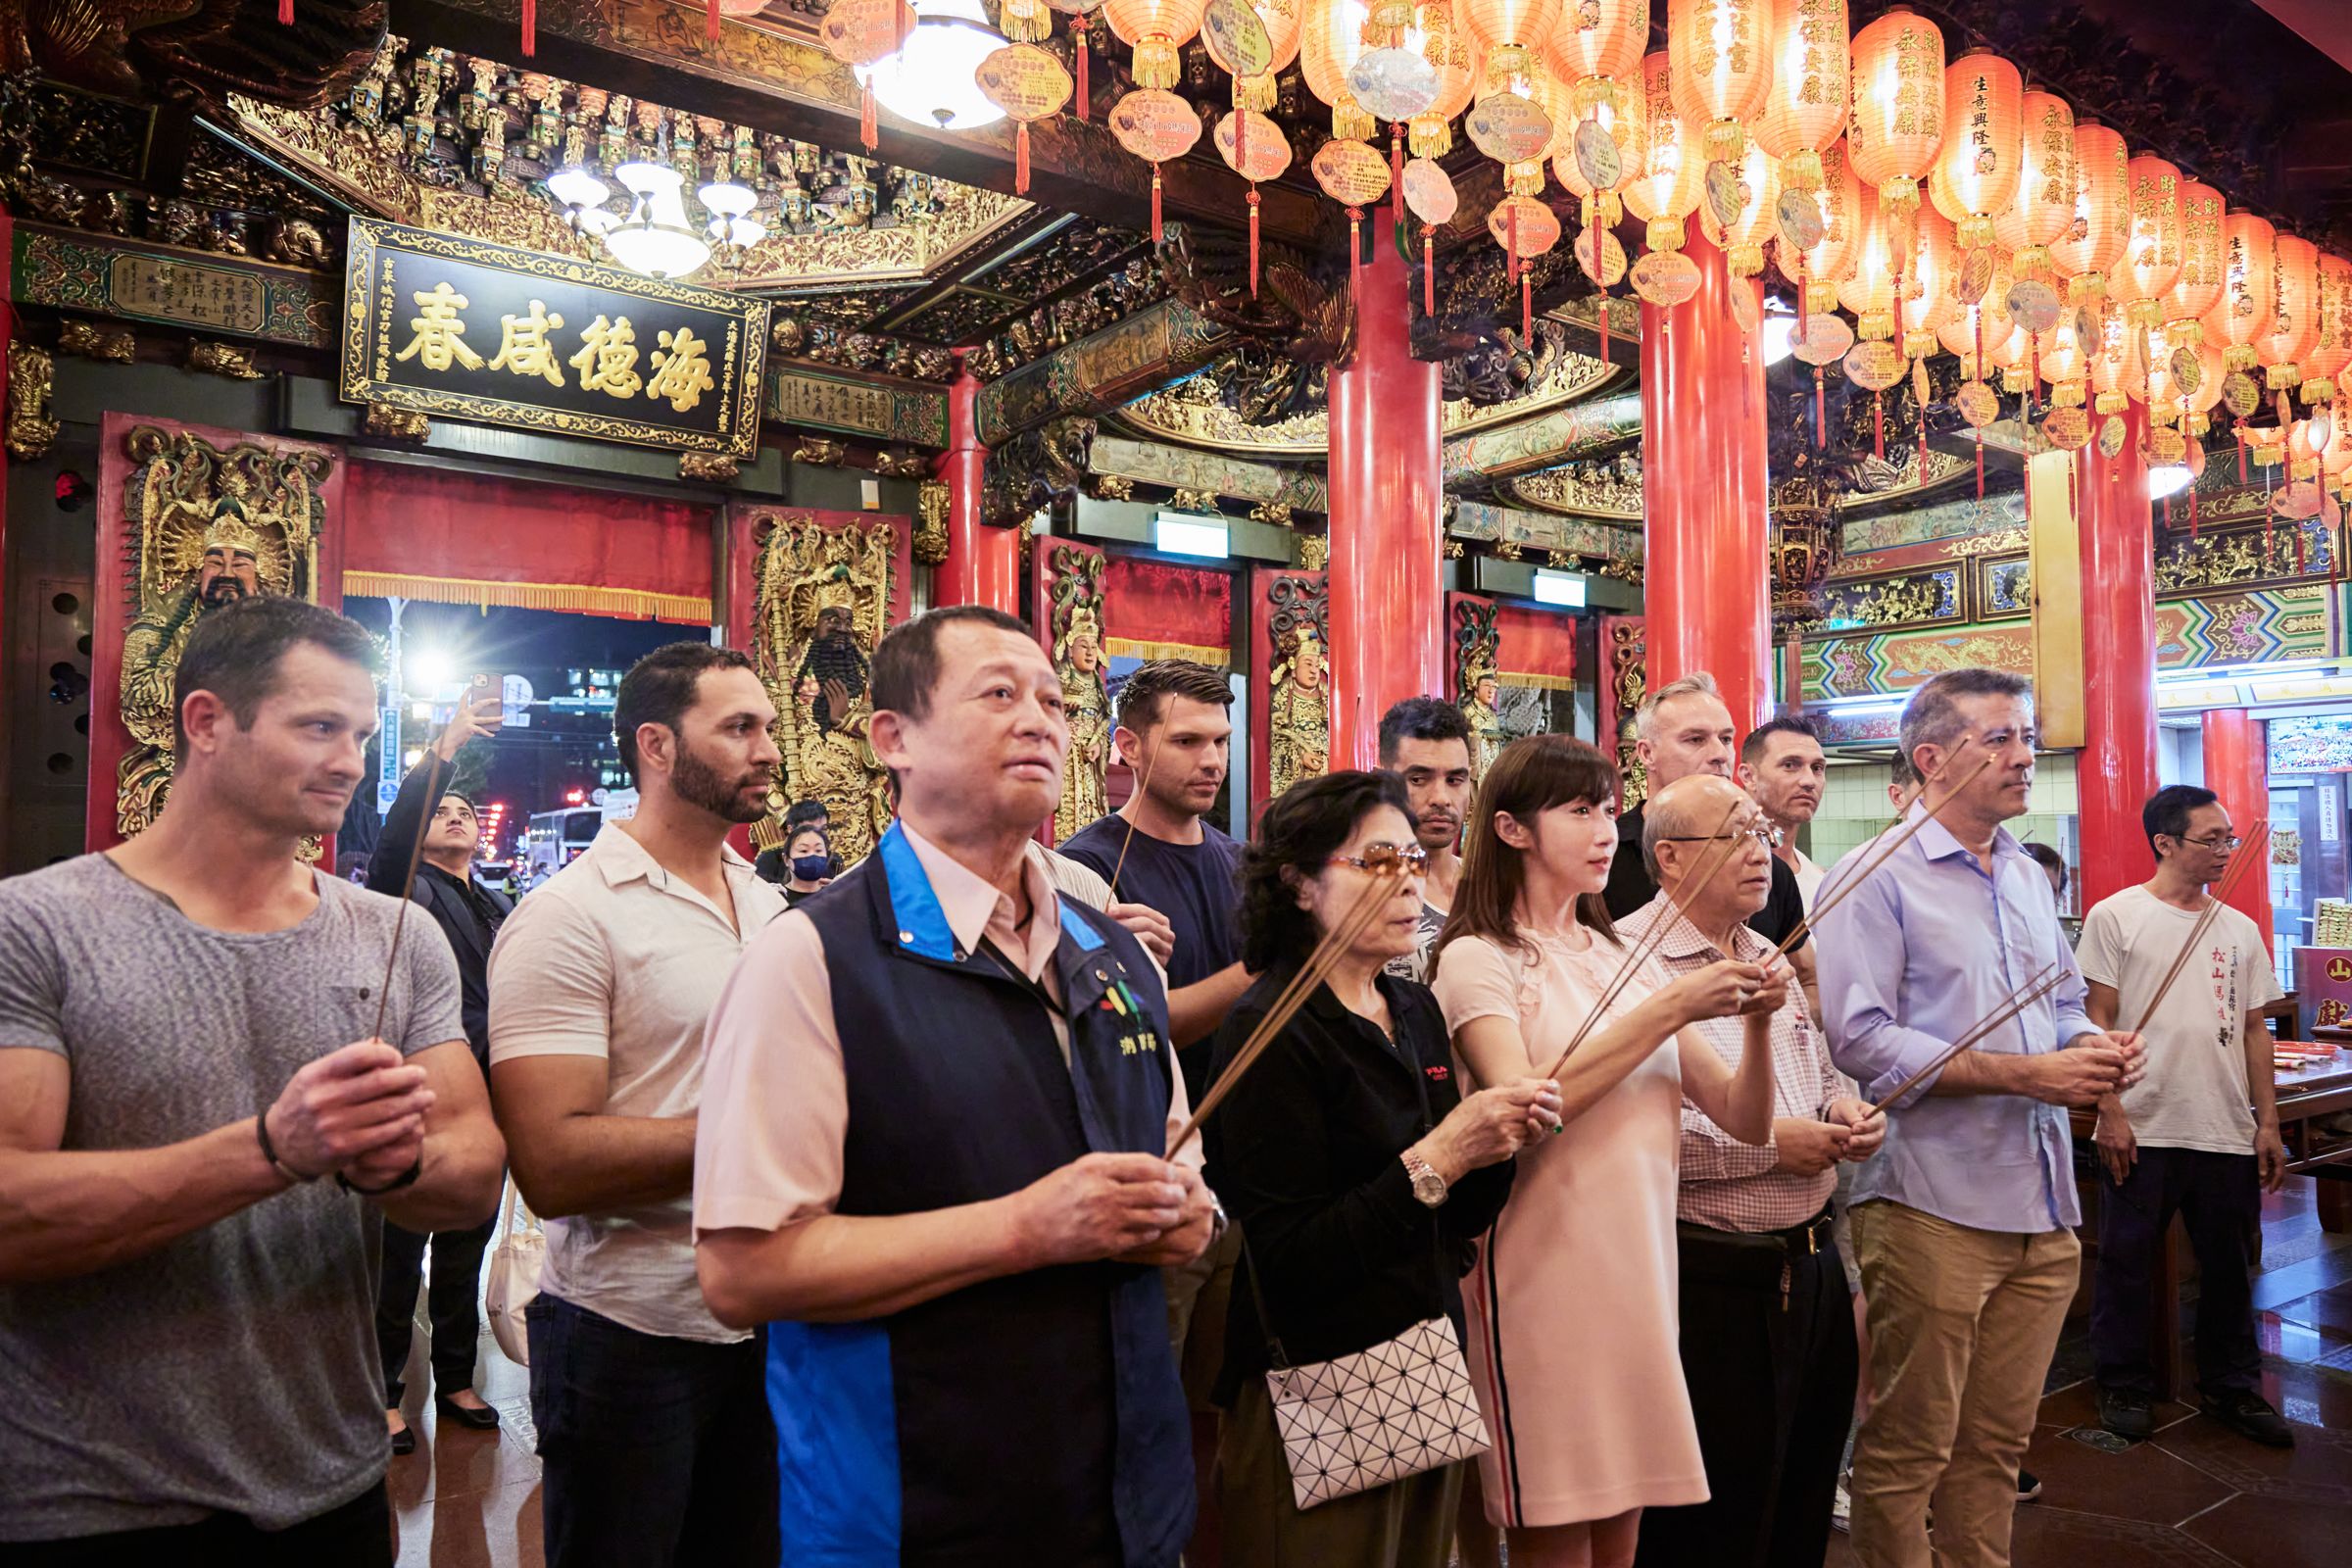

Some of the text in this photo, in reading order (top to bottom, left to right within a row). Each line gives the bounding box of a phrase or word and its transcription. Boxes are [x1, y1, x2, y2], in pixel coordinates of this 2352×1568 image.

[1423, 0, 1447, 67] 安康
[1892, 26, 1923, 135] 永保安康
[1971, 76, 1990, 145] 生意興隆
[2040, 105, 2067, 205] 永保安康
[2229, 236, 2248, 293] 生意興隆
[2329, 958, 2351, 978] 山
